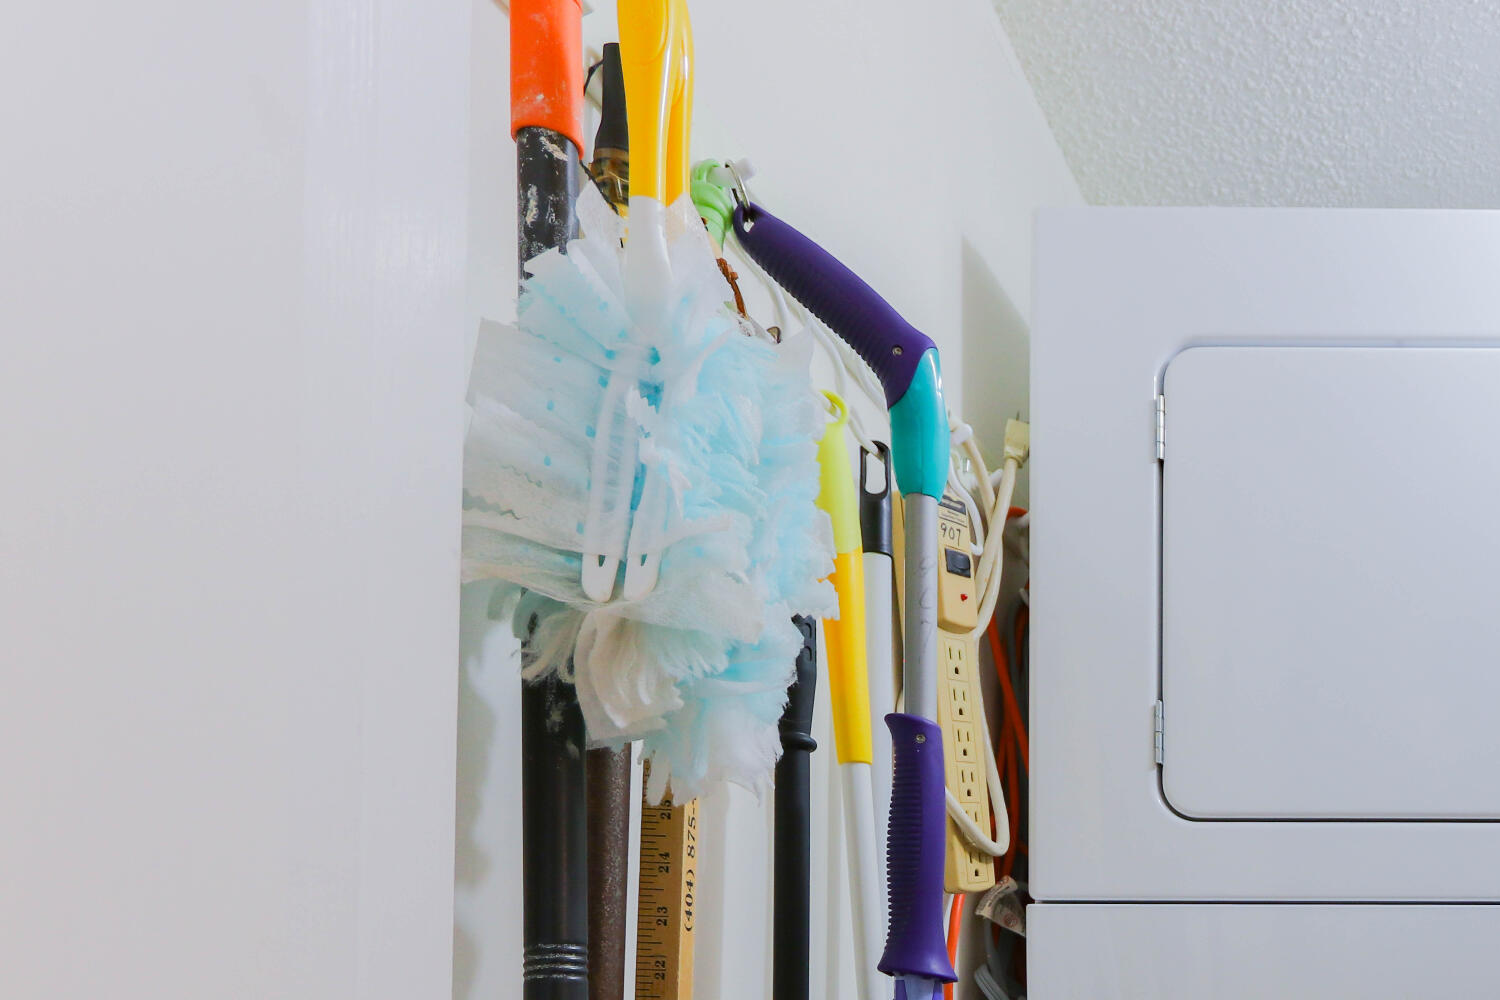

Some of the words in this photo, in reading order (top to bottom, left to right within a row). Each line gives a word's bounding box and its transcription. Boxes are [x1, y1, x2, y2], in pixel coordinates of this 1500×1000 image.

[941, 522, 962, 546] 907
[687, 797, 697, 858] 875-
[685, 869, 697, 933] (404)
